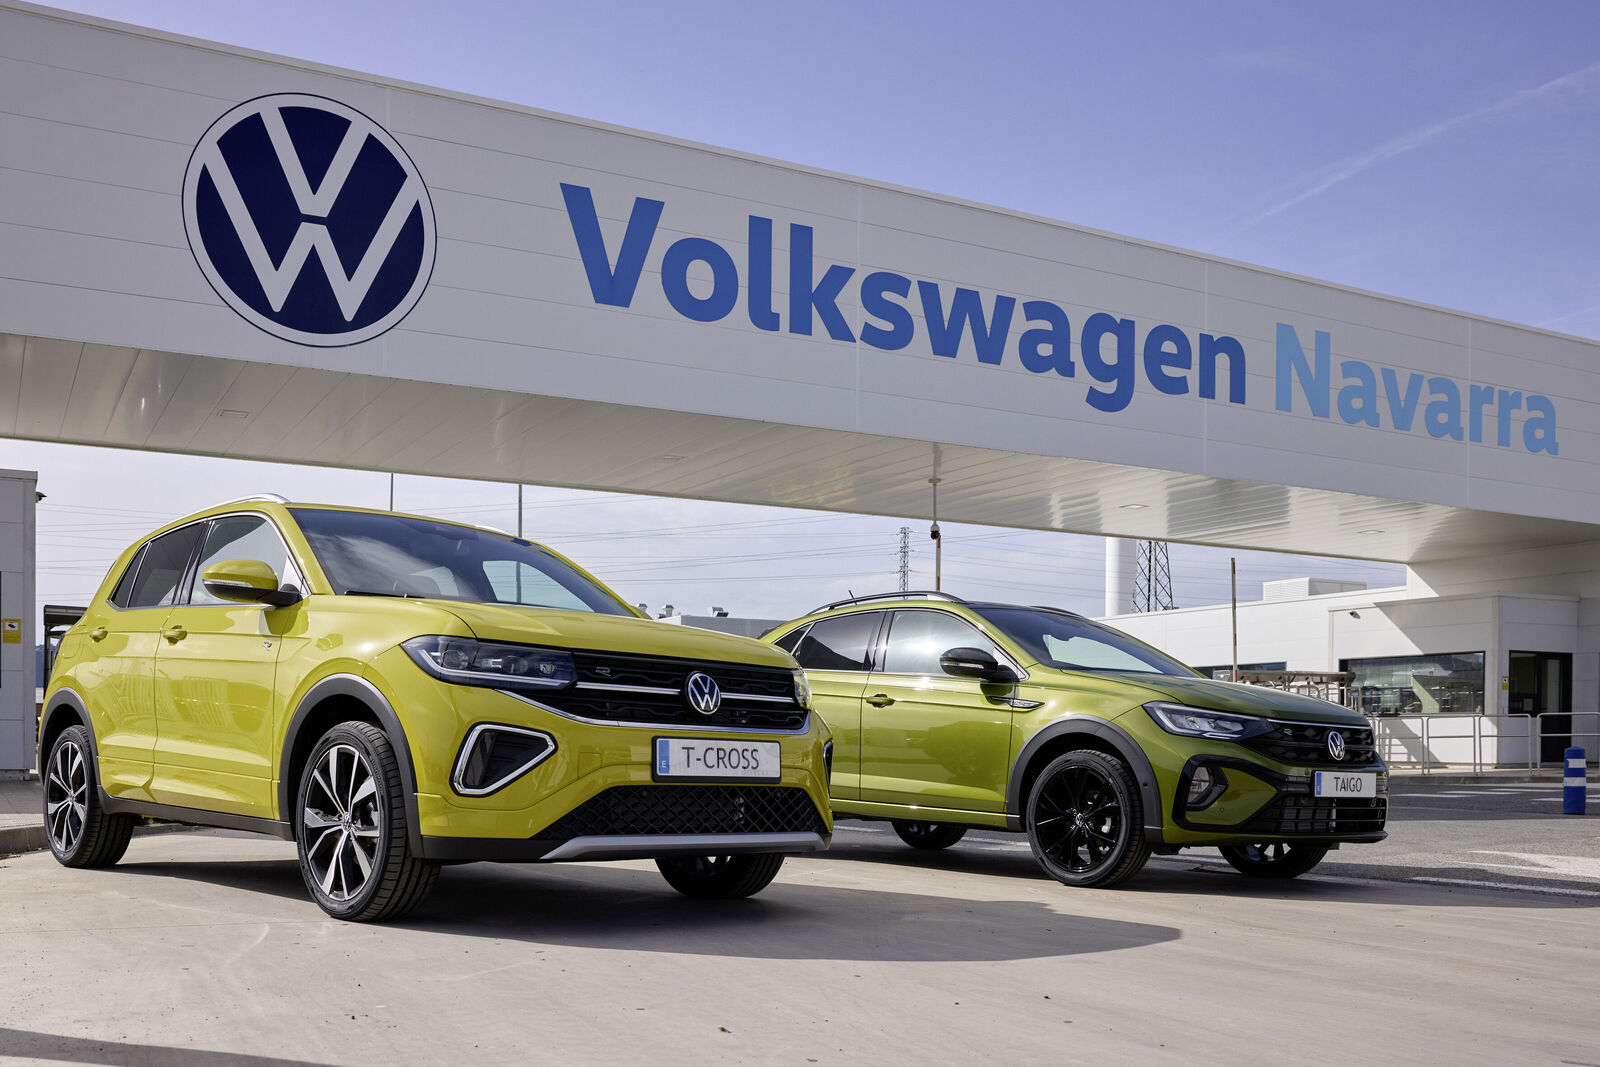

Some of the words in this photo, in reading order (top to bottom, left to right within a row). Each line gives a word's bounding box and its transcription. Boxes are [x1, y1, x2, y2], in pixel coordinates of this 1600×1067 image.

[194, 104, 426, 336] VW
[560, 182, 1247, 413] Volkswagen
[1276, 323, 1560, 456] Navarra
[687, 673, 721, 714] VW
[681, 746, 760, 770] T-CROSS
[1333, 776, 1363, 793] TAIGO
